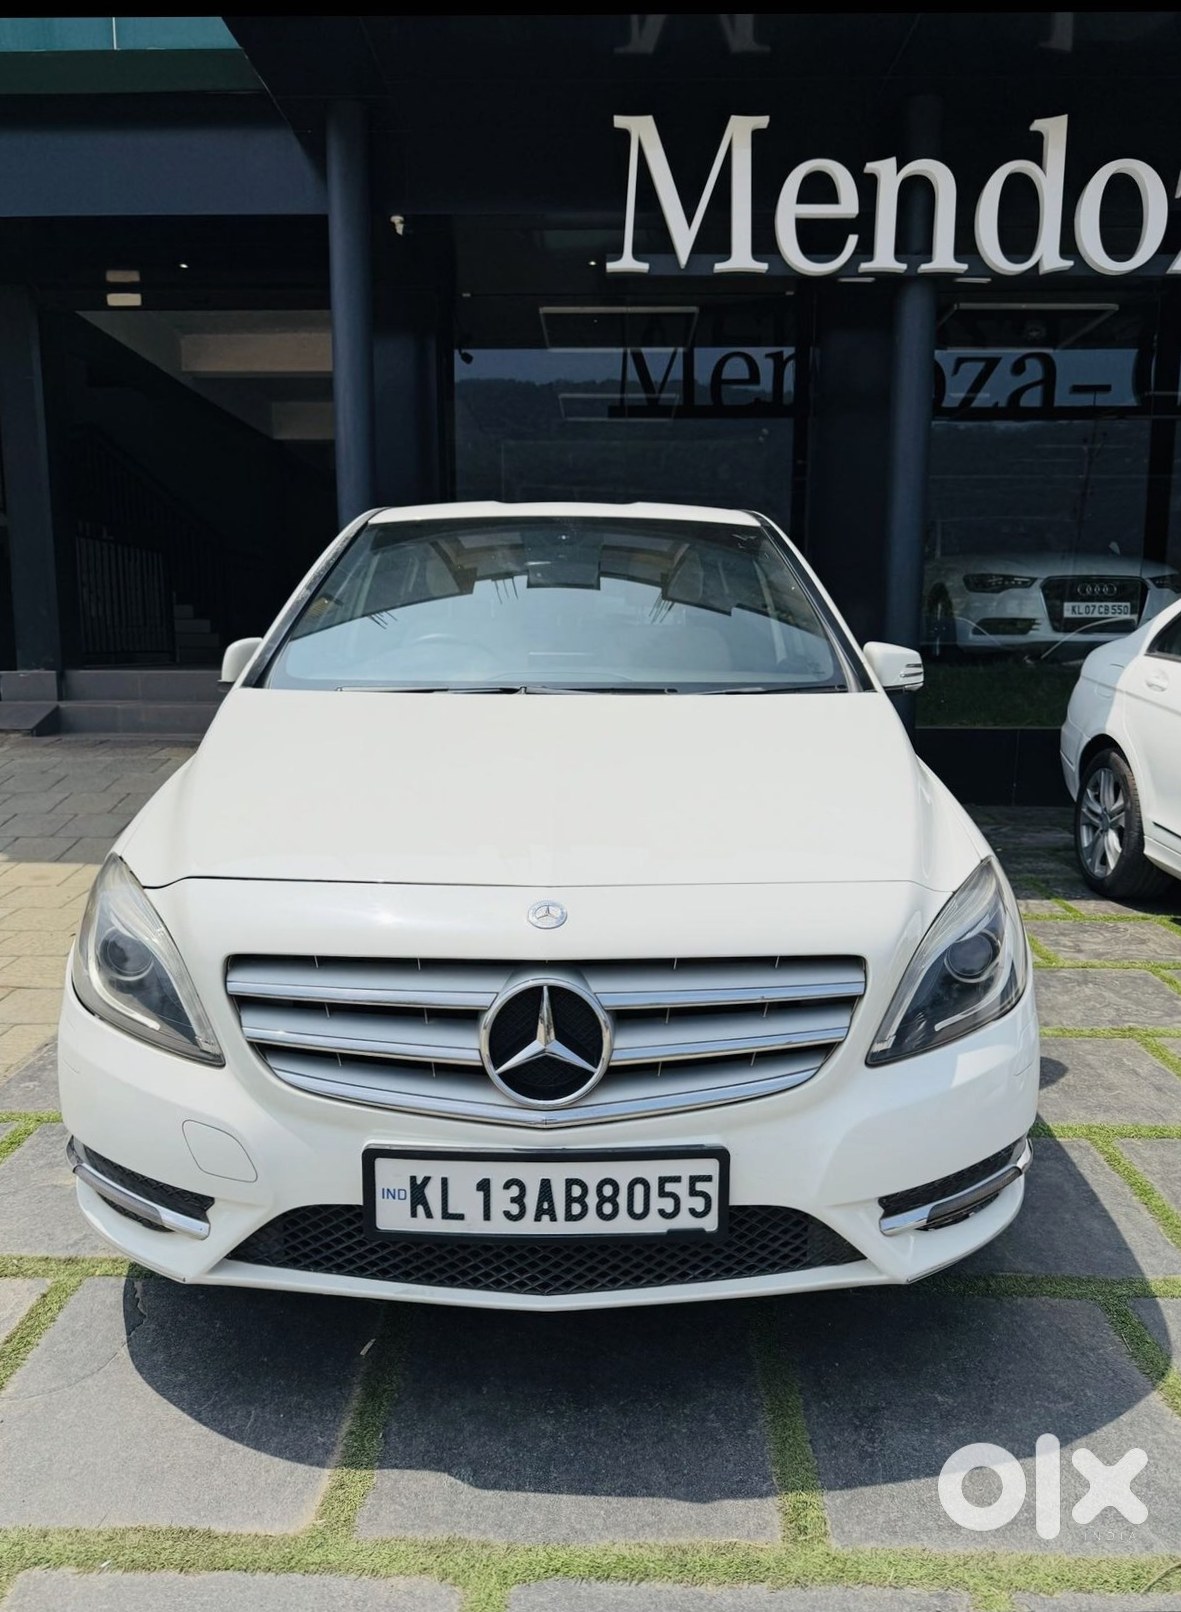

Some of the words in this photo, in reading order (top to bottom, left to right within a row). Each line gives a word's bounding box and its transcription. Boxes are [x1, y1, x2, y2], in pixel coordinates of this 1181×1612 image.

[605, 113, 1181, 277] Mendo
[381, 1187, 407, 1201] IND
[409, 1174, 713, 1223] KL13AB8055
